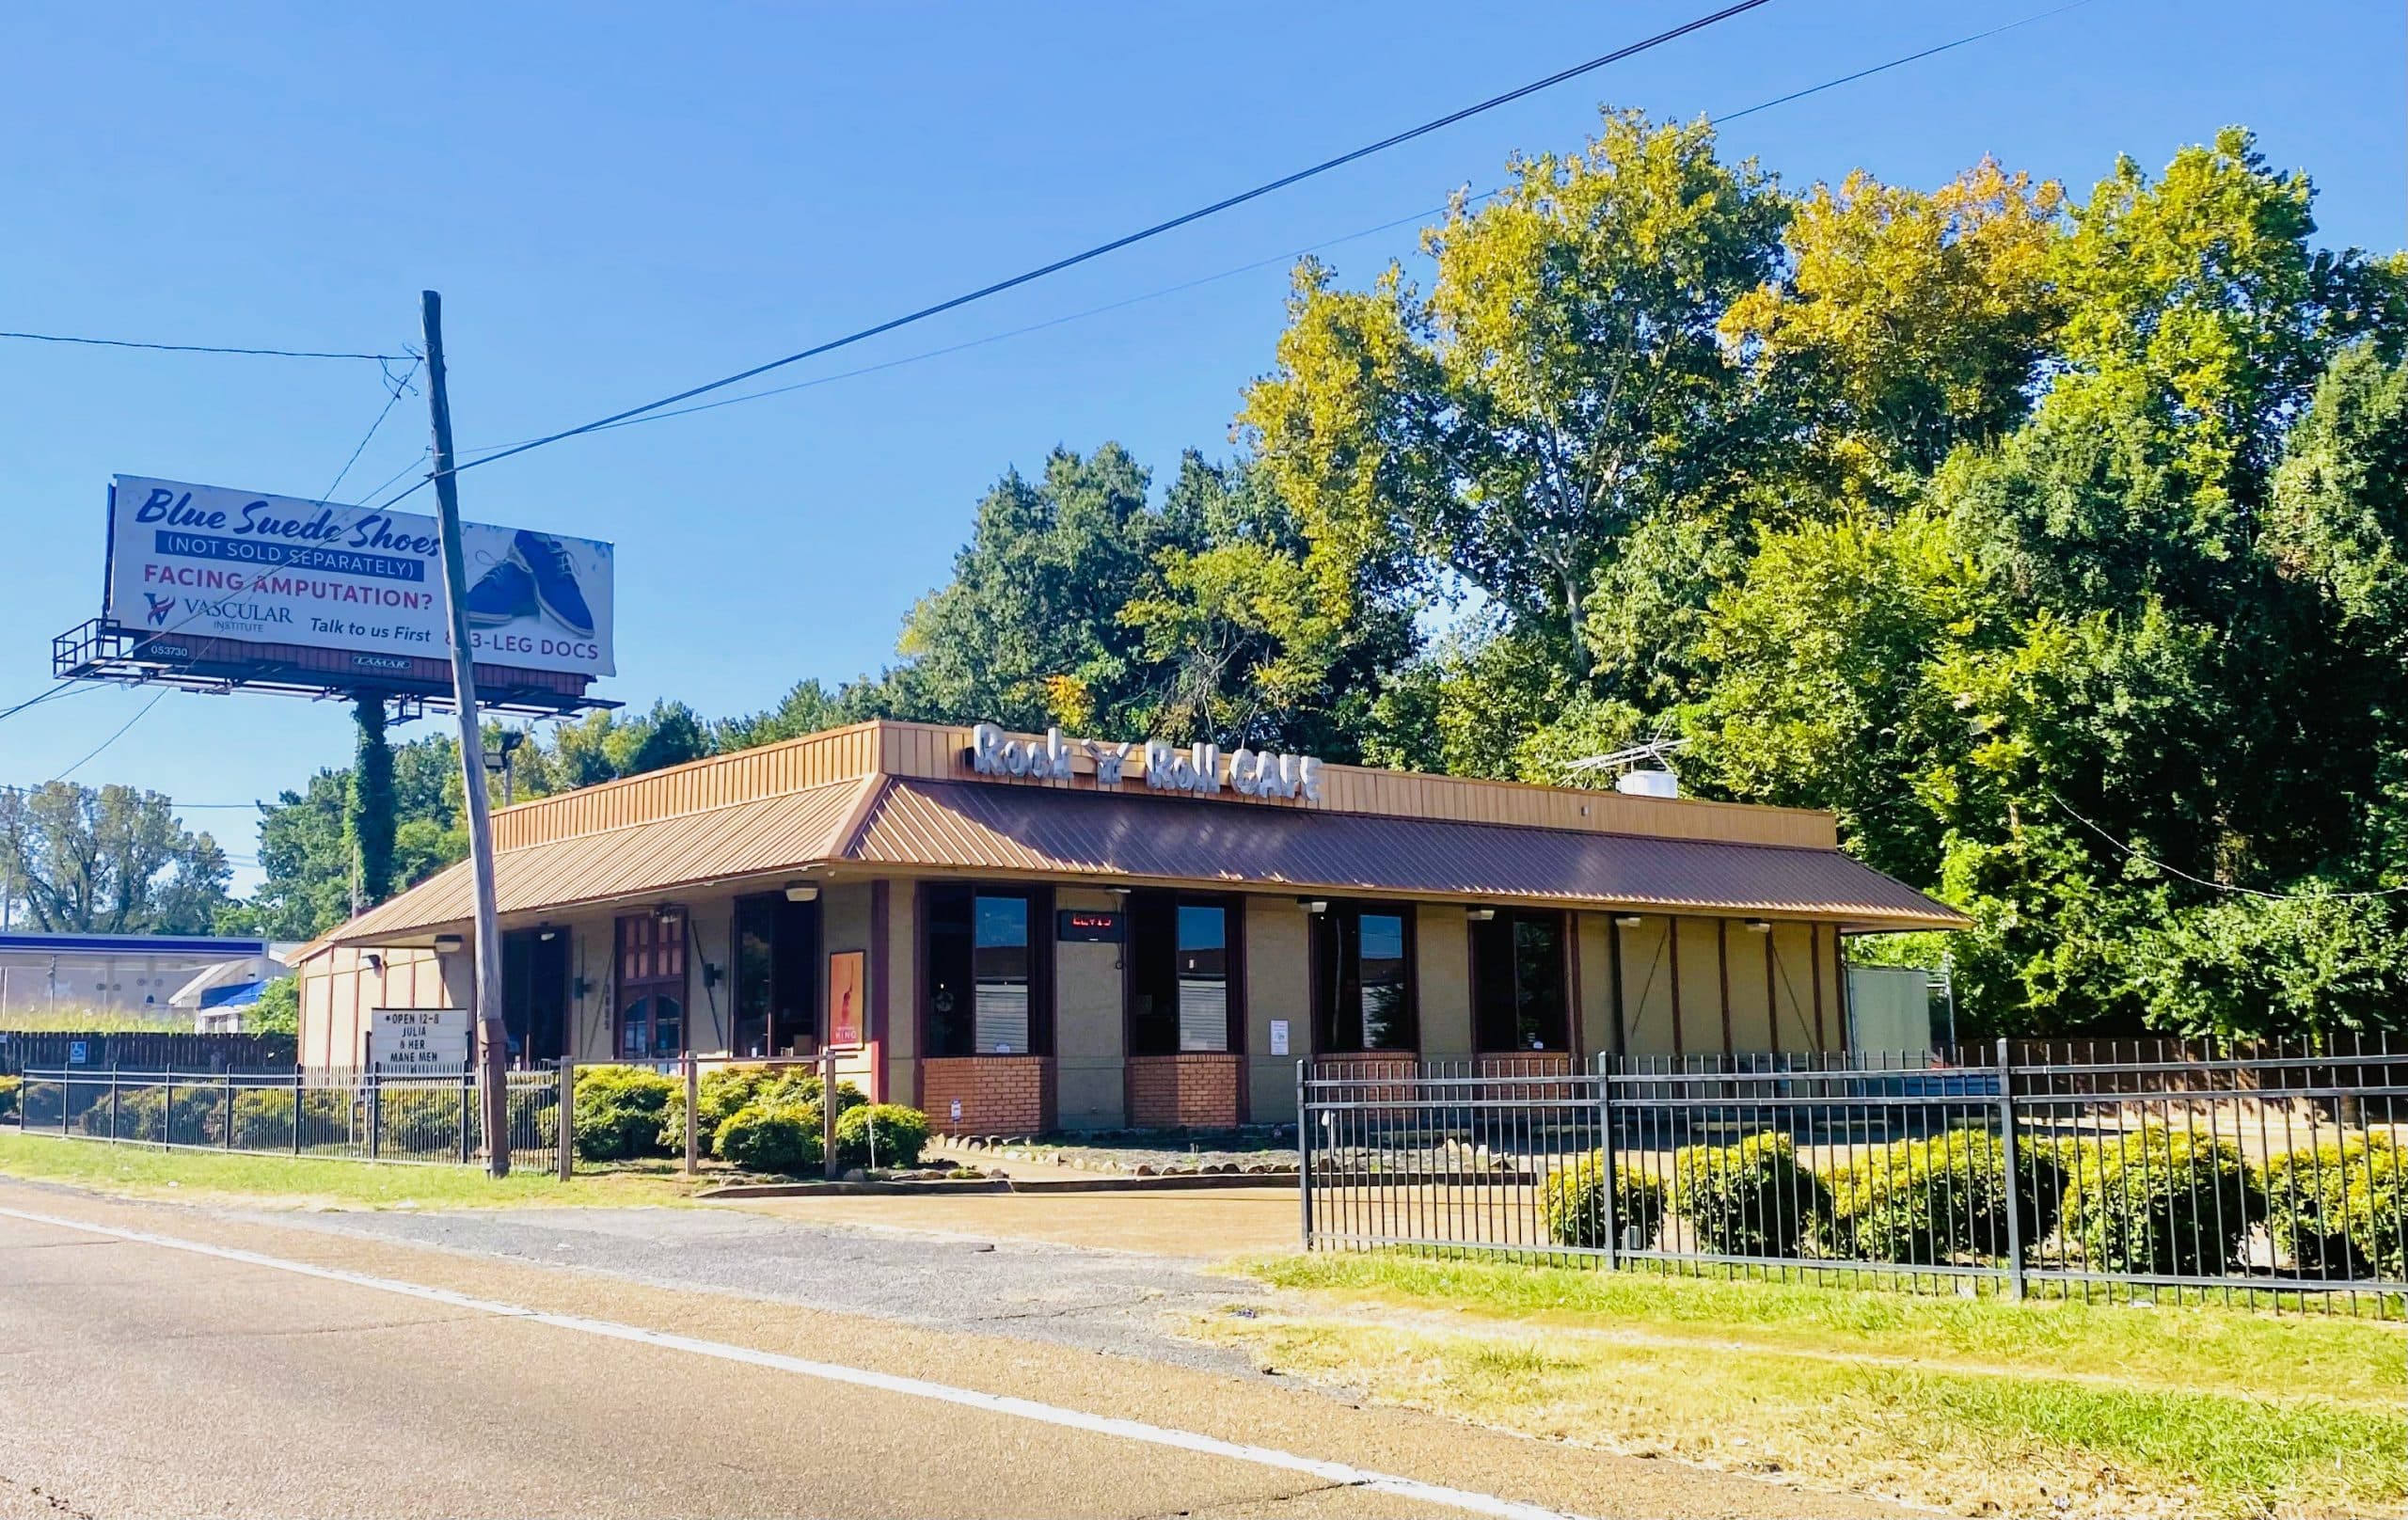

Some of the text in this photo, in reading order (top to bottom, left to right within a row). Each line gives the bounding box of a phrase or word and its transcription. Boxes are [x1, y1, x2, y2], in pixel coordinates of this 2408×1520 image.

[135, 488, 440, 557] Blue Suede Shoes
[167, 534, 414, 578] (NOT SOLD SEPARATELY)
[144, 564, 433, 610] FACING AMPUTATION?
[183, 598, 293, 624] VASCULAR
[214, 620, 264, 633] INSTITUTE
[310, 617, 431, 642] Talk to us First
[150, 645, 188, 657] 053730
[445, 629, 598, 660] 3-LEG DOCS
[357, 657, 405, 669] LAMAR
[973, 722, 1074, 780] Rock
[1145, 738, 1220, 794] Roll
[1229, 748, 1324, 801] CAFE
[402, 1026, 426, 1037] JULIA
[408, 1039, 425, 1050] HER
[390, 1053, 415, 1063] MANE
